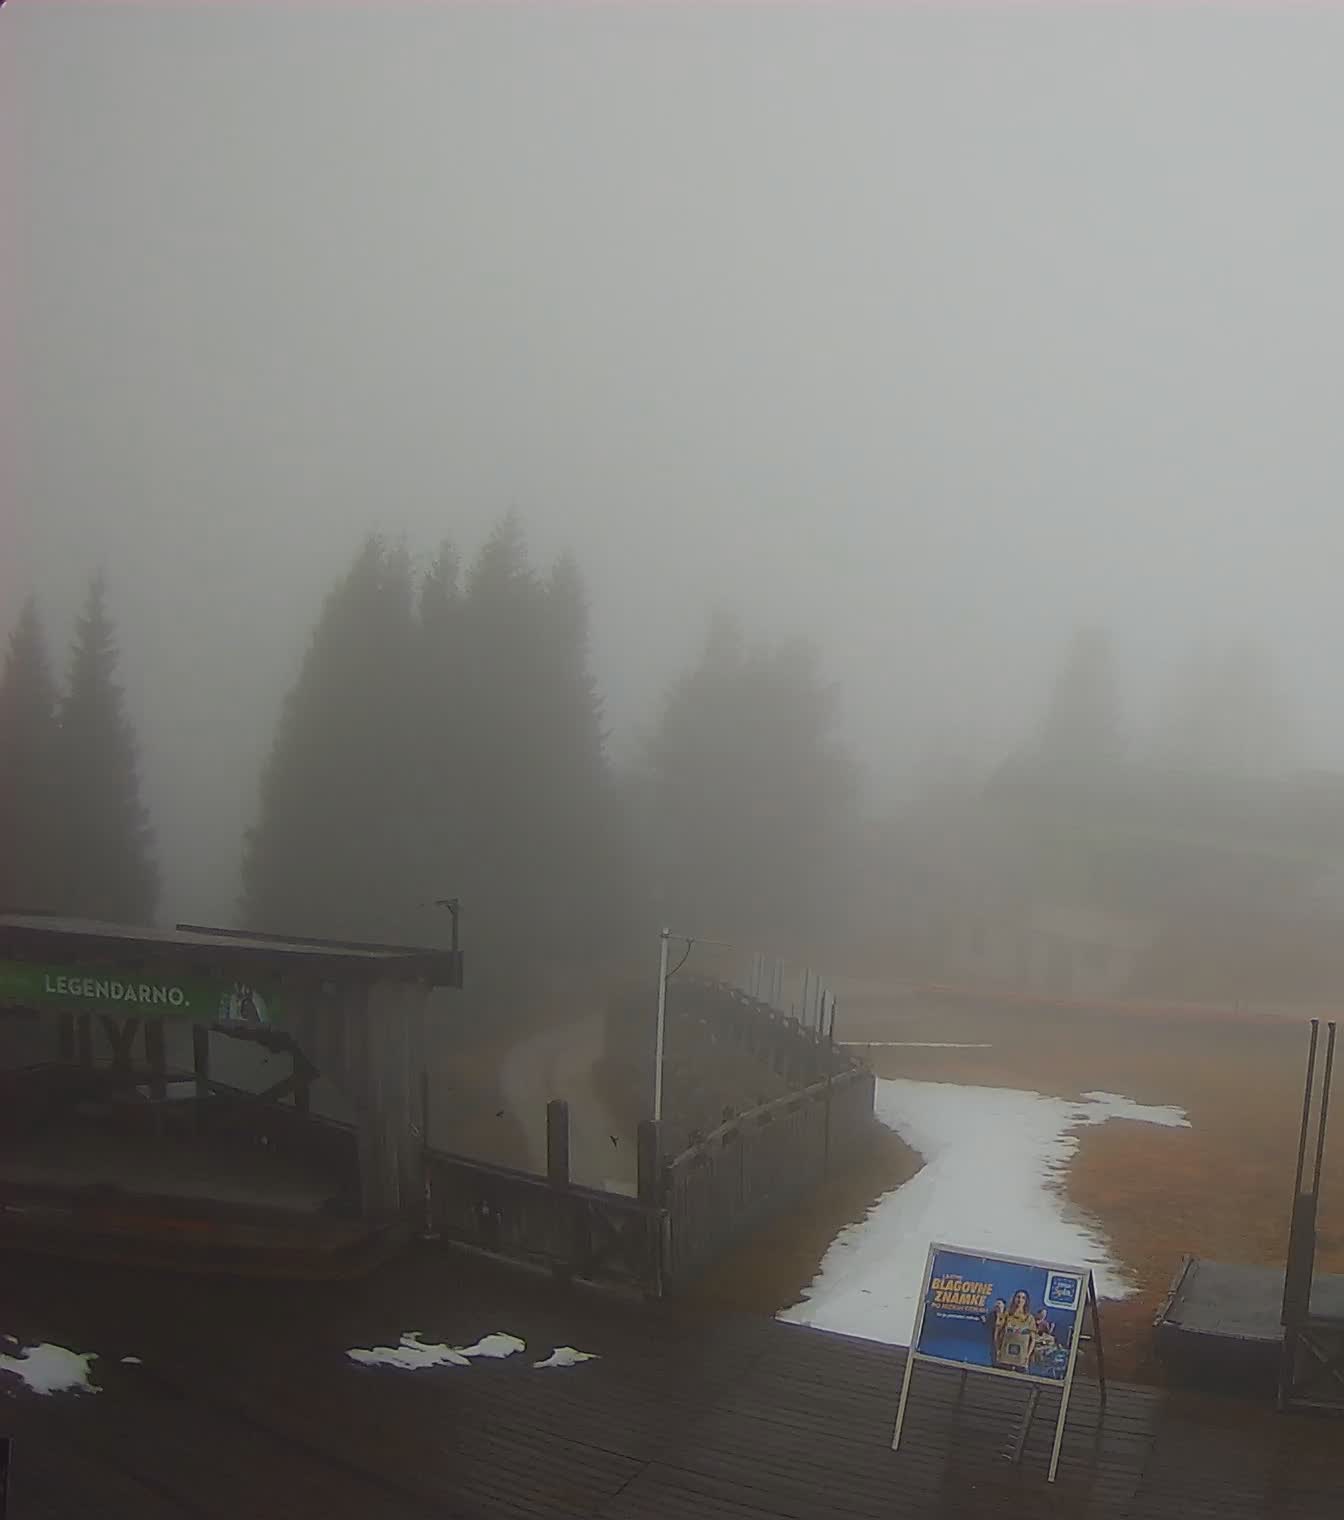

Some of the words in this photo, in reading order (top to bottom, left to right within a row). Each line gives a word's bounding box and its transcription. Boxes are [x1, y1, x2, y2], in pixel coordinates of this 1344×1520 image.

[45, 974, 191, 1007] LEGENDARNO.
[931, 1278, 993, 1295] BLAGOVNE
[934, 1290, 988, 1307] ZNAMKE
